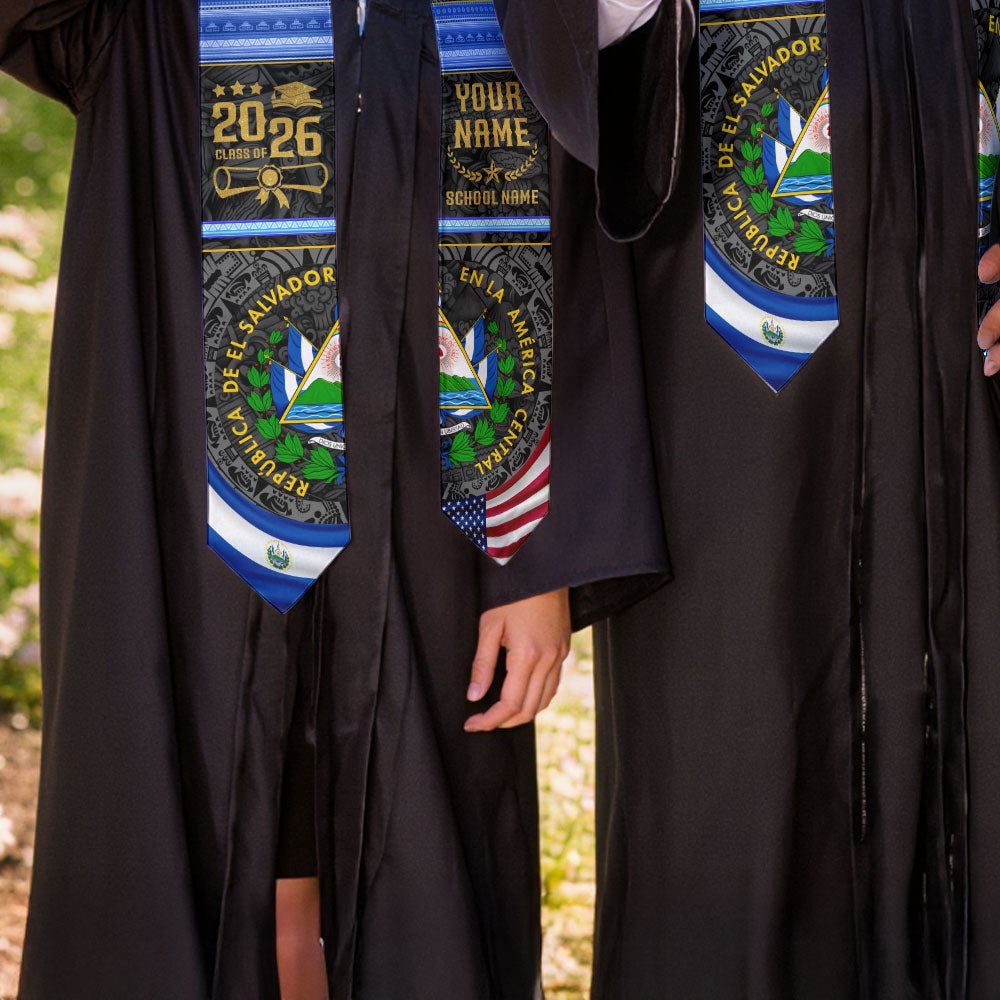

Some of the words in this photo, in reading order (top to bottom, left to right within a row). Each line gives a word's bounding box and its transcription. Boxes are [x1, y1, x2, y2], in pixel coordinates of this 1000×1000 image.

[733, 35, 822, 107] SALVADOR
[455, 81, 524, 112] YOUR
[454, 117, 531, 149] NAME
[722, 114, 741, 136] EL
[215, 148, 250, 160] CLASS
[254, 147, 267, 159] OF
[718, 142, 734, 168] DE
[446, 190, 499, 206] SCHOOL
[501, 190, 539, 205] NAME
[723, 182, 800, 271] REPÚBLICA
[459, 266, 485, 287] EN
[238, 266, 336, 335] SALVADOR
[486, 280, 505, 304] LA
[226, 340, 248, 362] EL
[506, 308, 537, 395] AMÉRICA
[223, 367, 240, 394] DE
[227, 407, 309, 497] REPÚBLICA
[474, 408, 528, 476] CENTRAL
